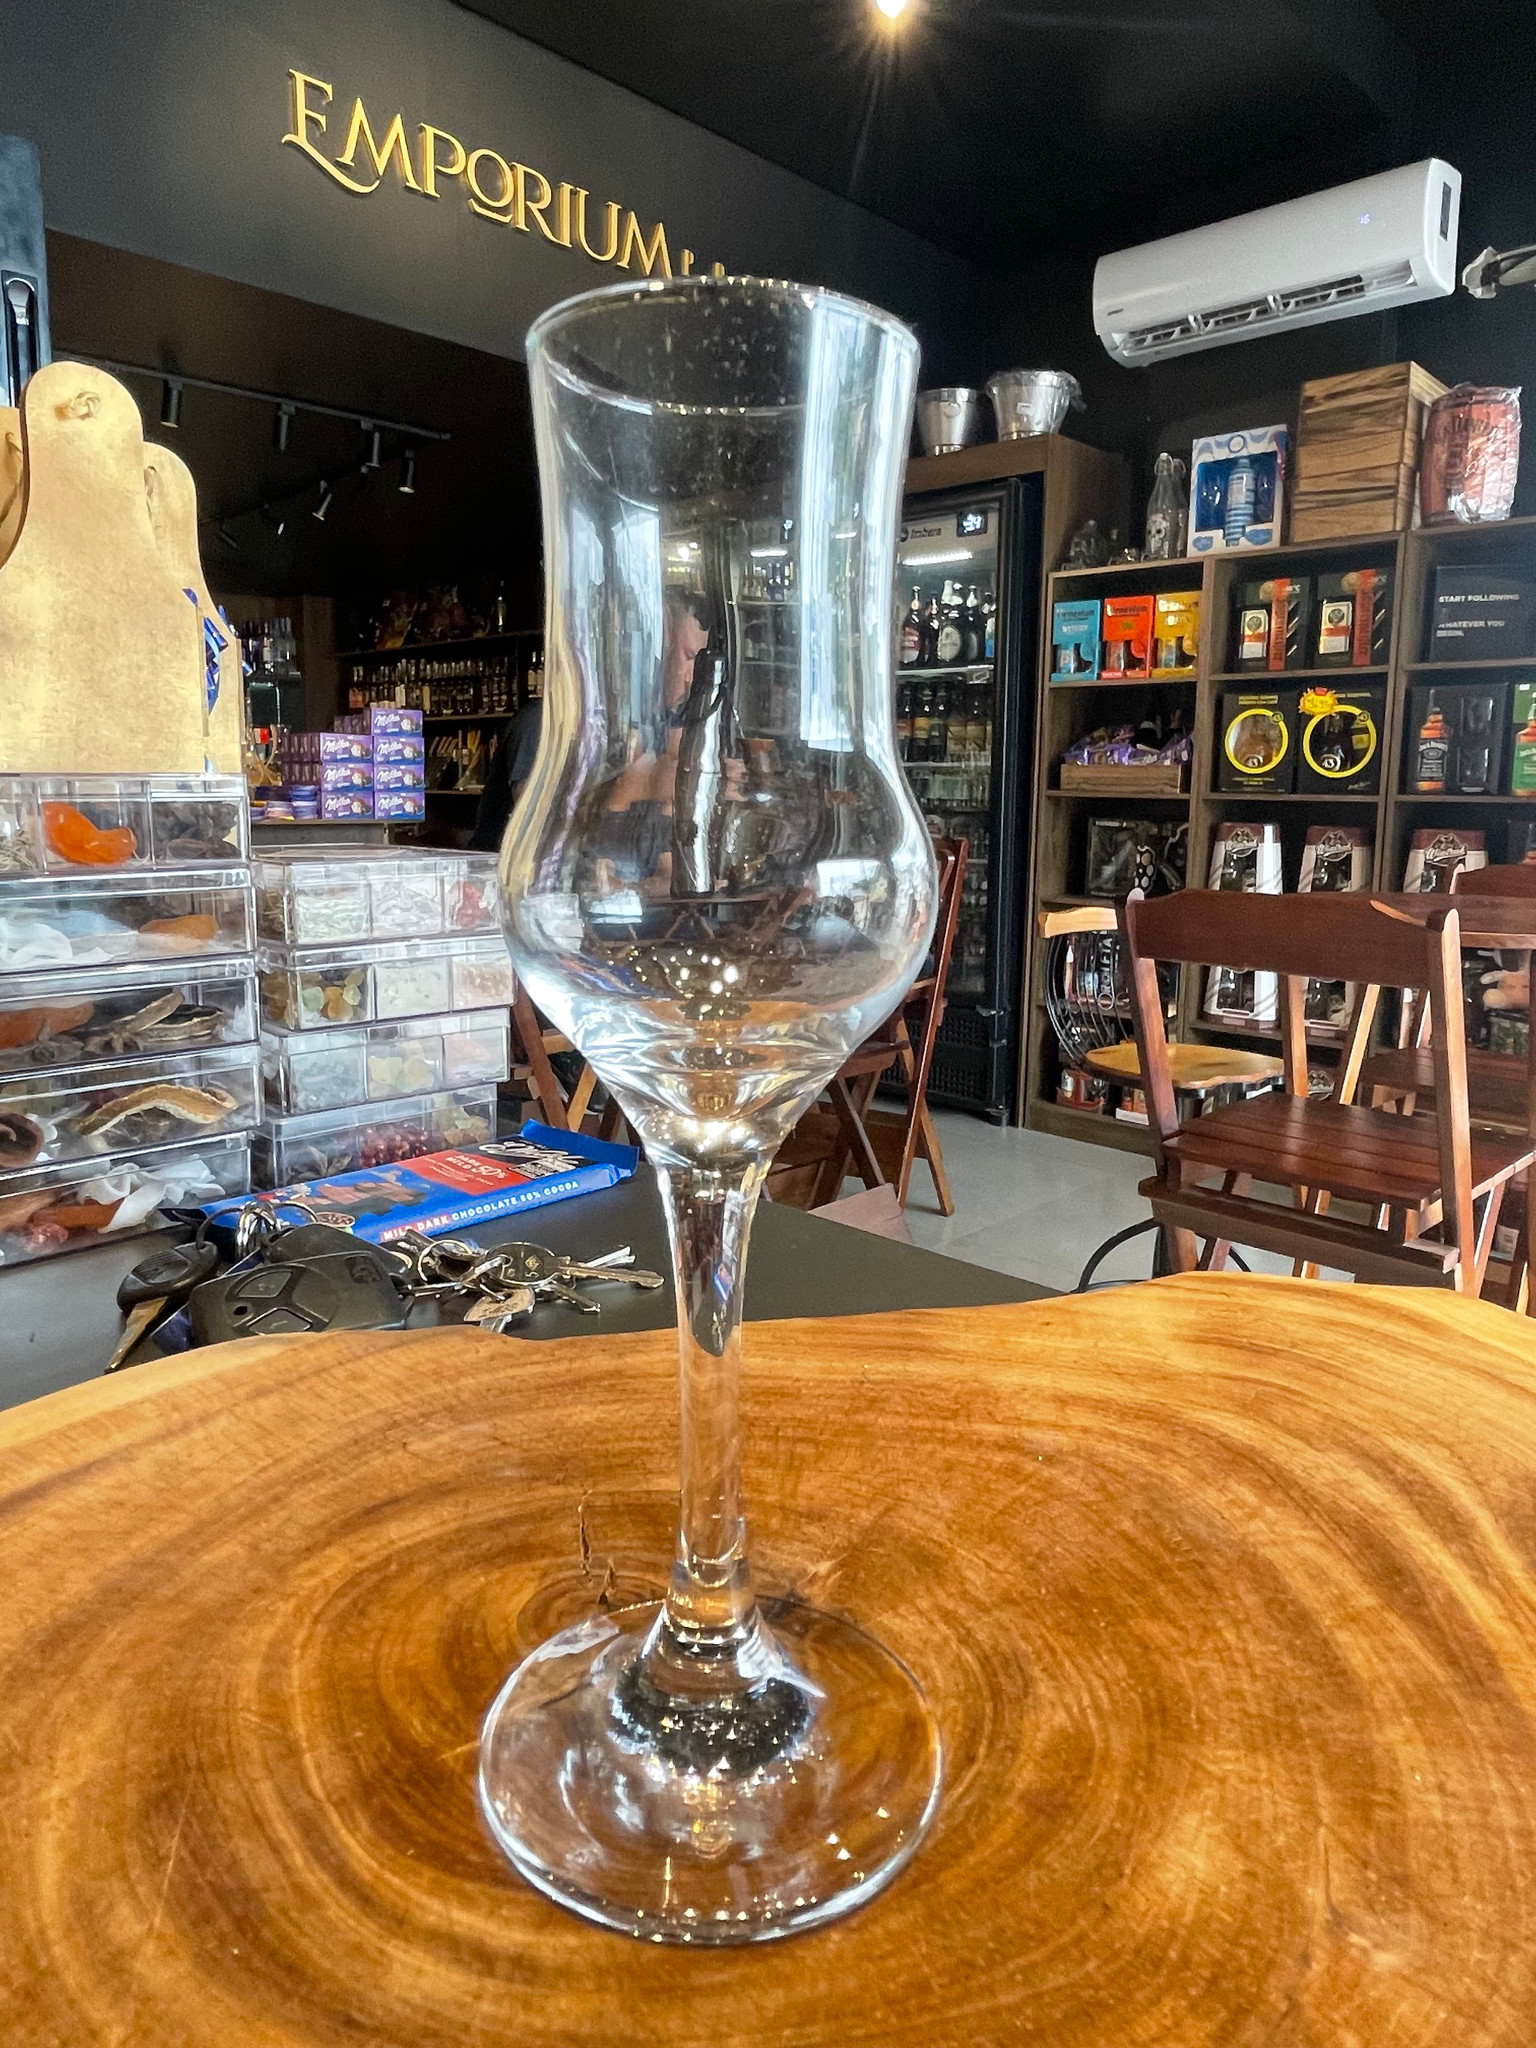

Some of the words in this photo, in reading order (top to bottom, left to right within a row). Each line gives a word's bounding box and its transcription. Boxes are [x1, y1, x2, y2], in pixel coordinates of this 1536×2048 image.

[282, 68, 673, 278] EMPORIUM
[1438, 595, 1466, 603] START
[417, 1215, 449, 1231] DARK
[451, 1196, 518, 1221] CHOCOLATE
[544, 1180, 580, 1196] COCOA
